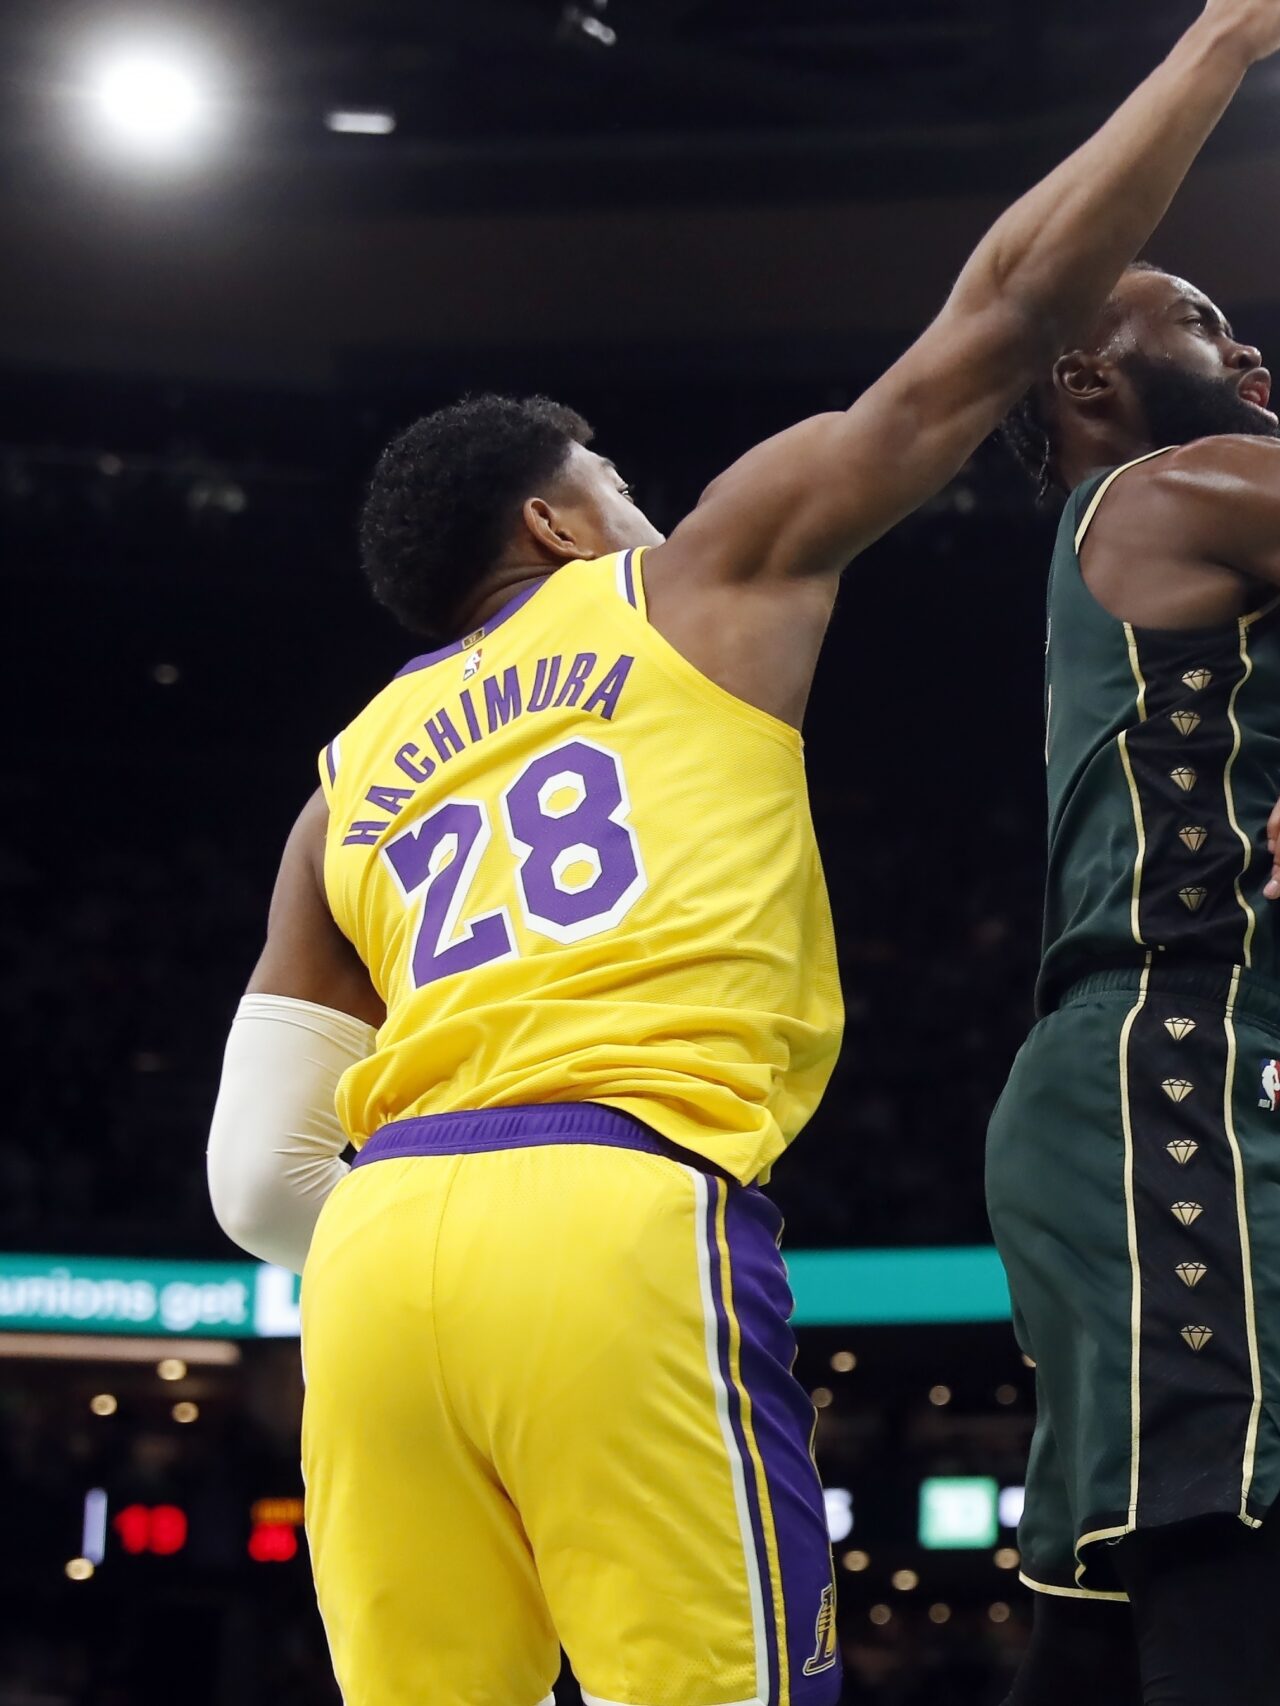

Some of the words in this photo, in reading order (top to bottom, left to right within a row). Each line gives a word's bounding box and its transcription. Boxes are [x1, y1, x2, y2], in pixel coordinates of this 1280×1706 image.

[341, 652, 636, 848] HACHIMURA
[380, 734, 649, 990] 28
[158, 1277, 248, 1332] get
